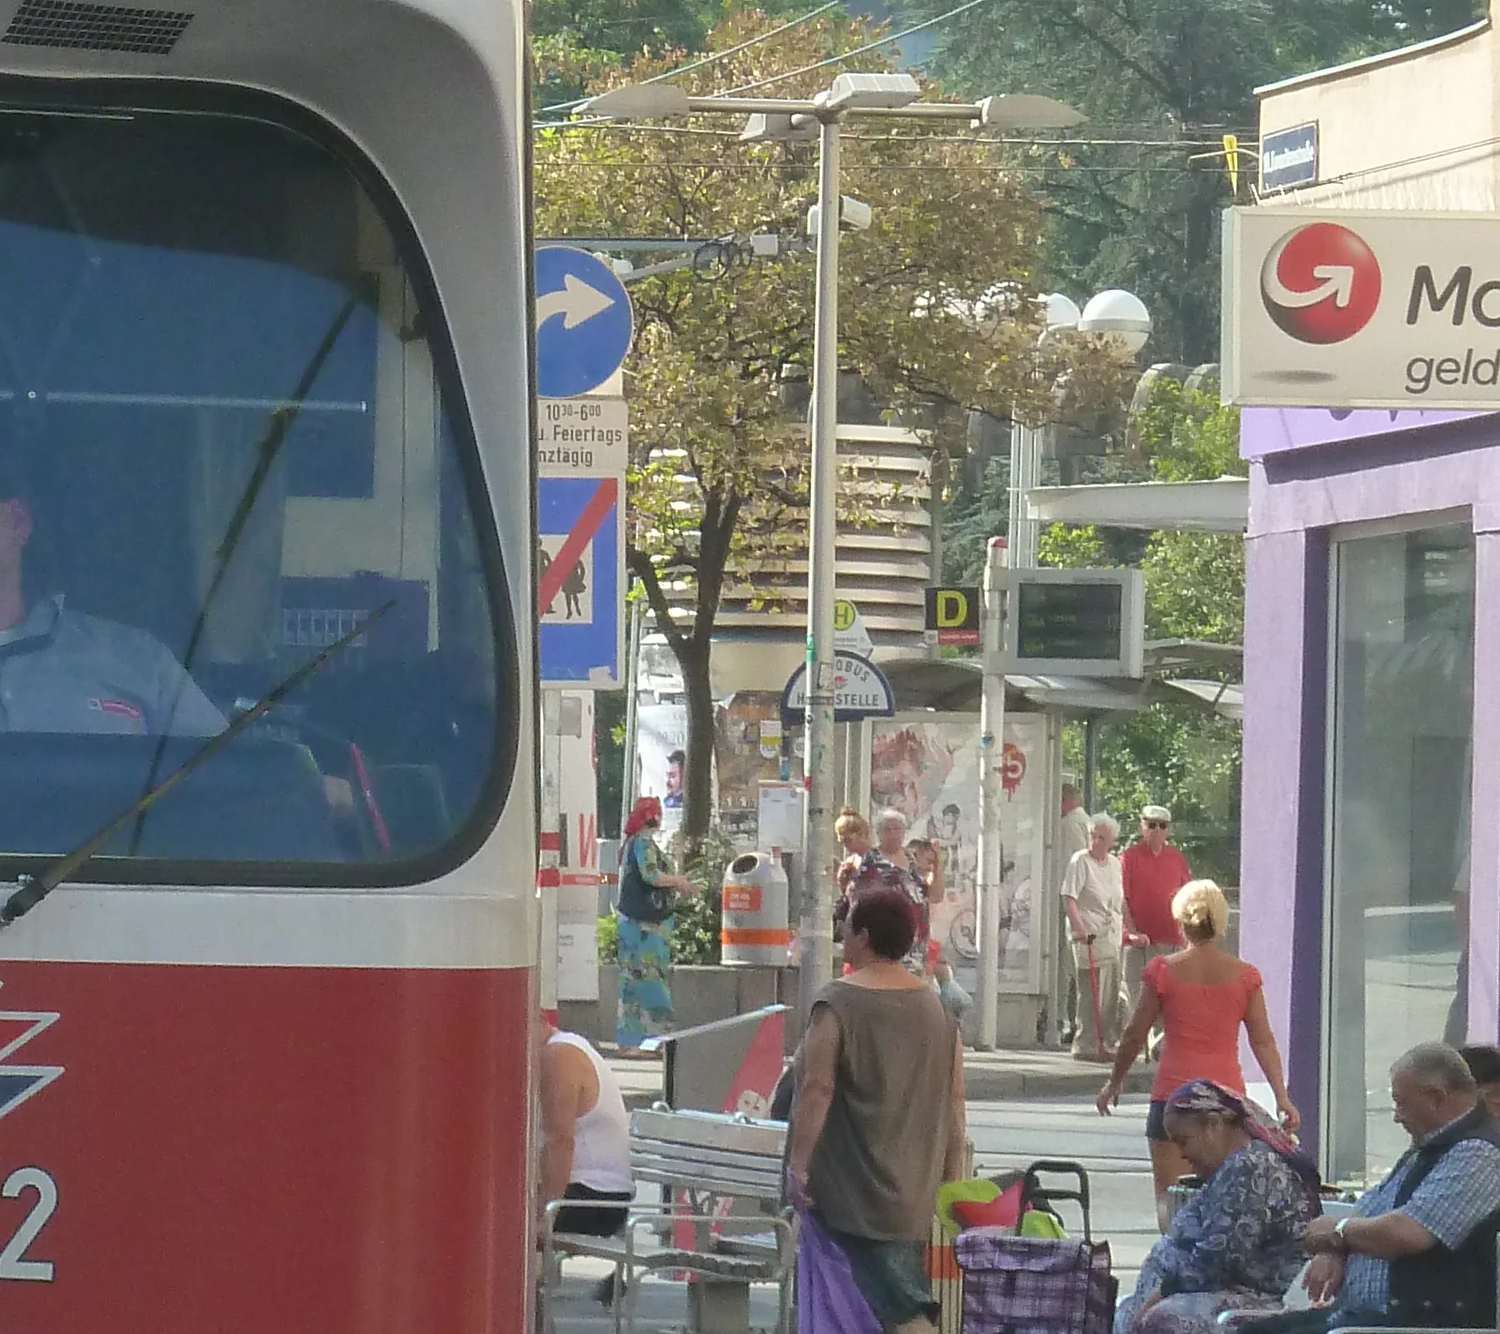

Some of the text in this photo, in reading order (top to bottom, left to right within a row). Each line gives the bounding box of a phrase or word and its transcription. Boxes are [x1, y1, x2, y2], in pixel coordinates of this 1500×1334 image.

[553, 425, 622, 446] Feiertags
[835, 606, 849, 625] H
[936, 590, 968, 627] D
